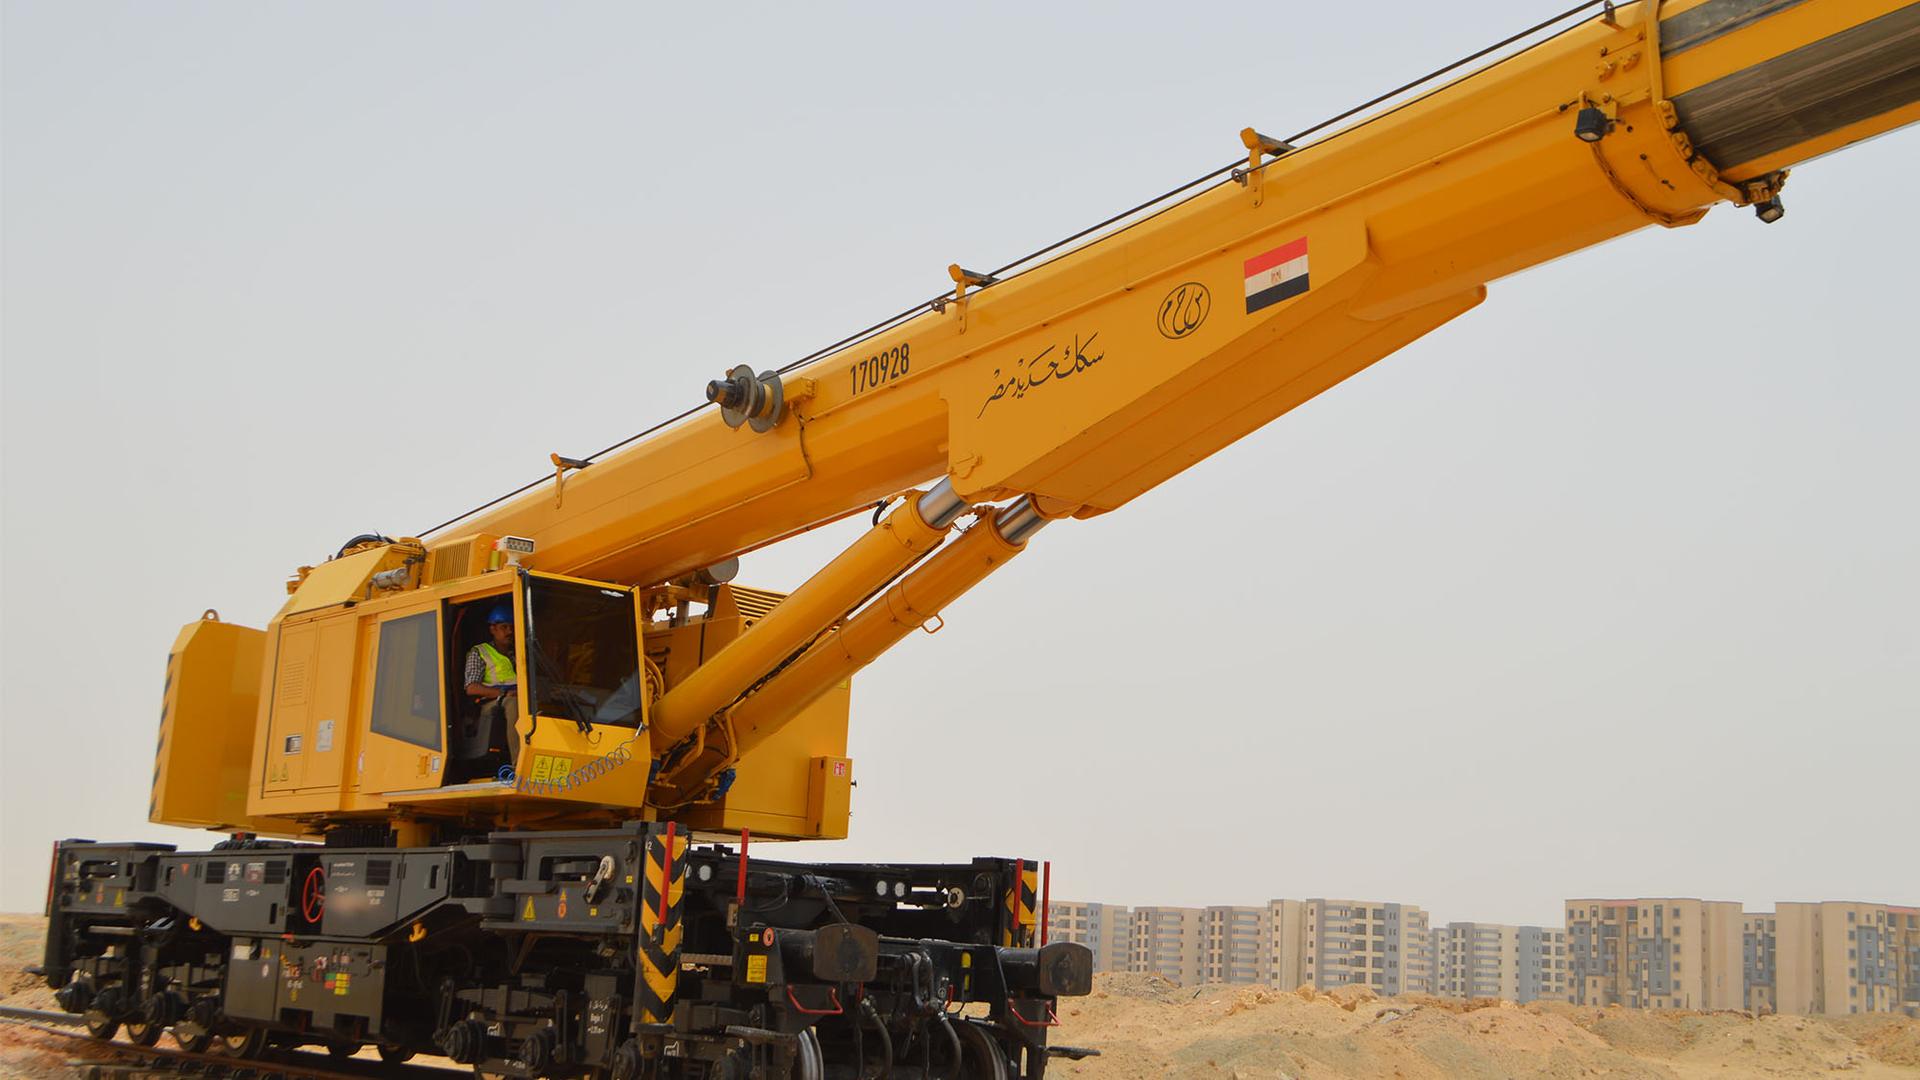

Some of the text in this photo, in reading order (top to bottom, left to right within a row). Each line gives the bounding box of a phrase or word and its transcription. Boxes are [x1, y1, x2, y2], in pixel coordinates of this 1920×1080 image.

[850, 342, 910, 396] 170928
[976, 331, 1105, 420] سكك حديد مصر
